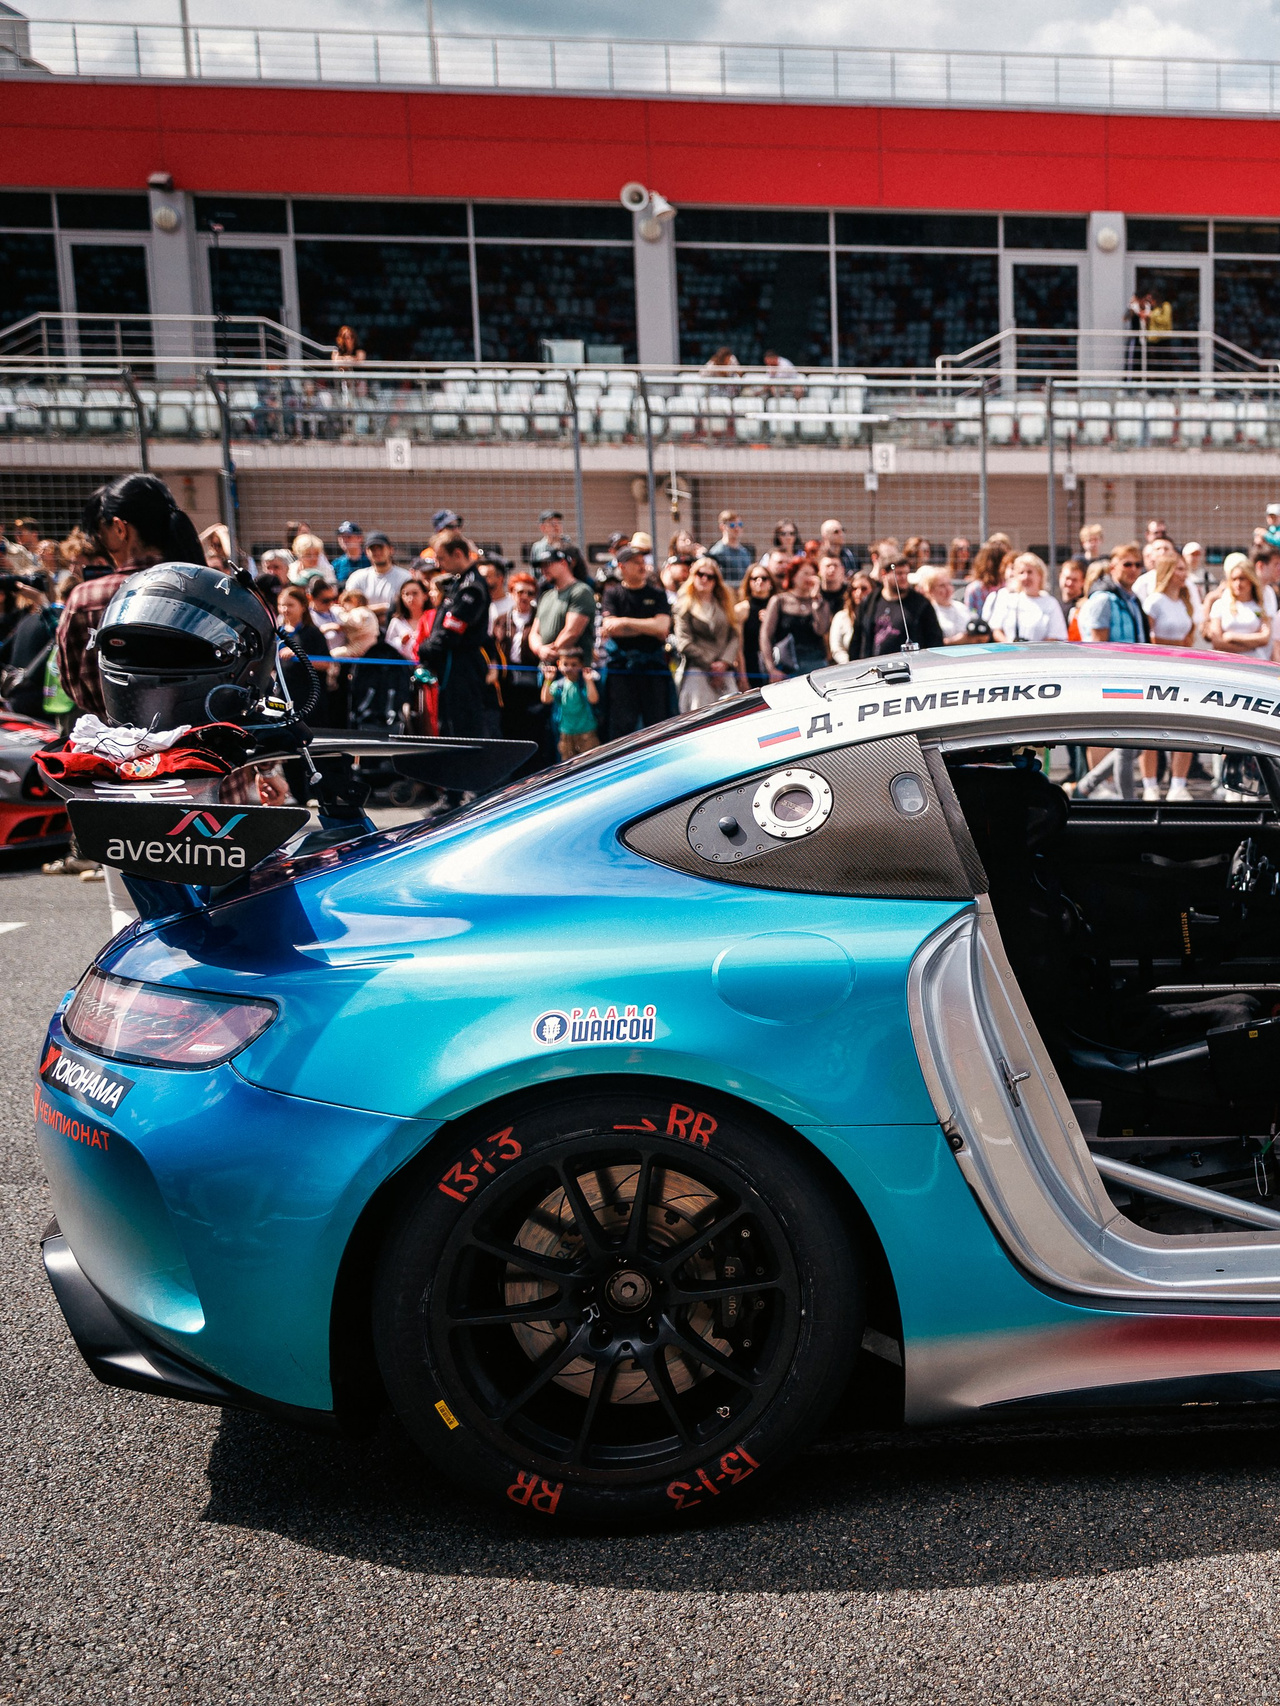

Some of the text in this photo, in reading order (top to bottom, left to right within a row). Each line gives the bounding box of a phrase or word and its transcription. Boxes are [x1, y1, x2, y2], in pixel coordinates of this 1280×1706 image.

[807, 683, 1062, 739] Д. РЕМЕНЯКО
[1146, 685, 1189, 702] М.
[106, 836, 246, 868] avexima
[571, 1018, 654, 1043] ШАНСОН
[573, 1006, 655, 1020] РАДИО
[51, 1055, 125, 1109] YOKOHAMA
[40, 1097, 110, 1151] ЧЕМПИОНАТ
[666, 1103, 718, 1149] RR
[506, 1470, 564, 1514] RR
